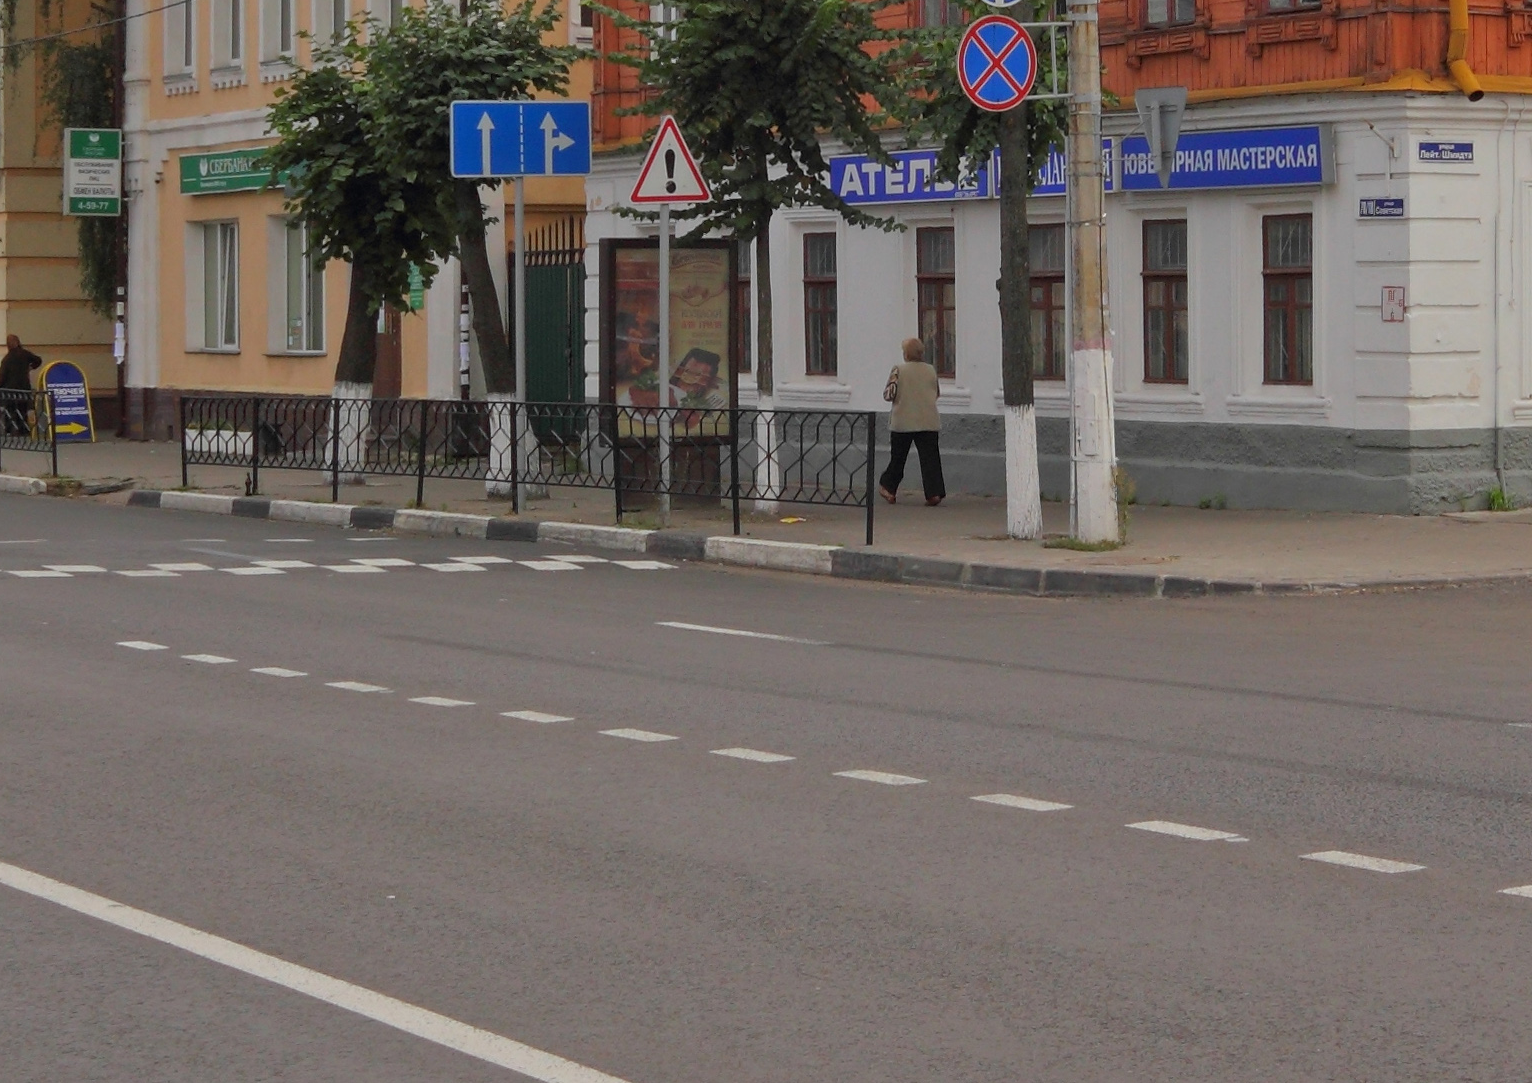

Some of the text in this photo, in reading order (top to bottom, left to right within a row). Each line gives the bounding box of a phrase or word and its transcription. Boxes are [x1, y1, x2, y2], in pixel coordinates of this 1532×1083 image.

[210, 157, 248, 175] СБЕРБАНК
[1123, 147, 1213, 175] ЮВЕРНАЯ
[1217, 143, 1318, 171] МАСТЕРСКАЯ
[78, 202, 109, 210] 4-59-77
